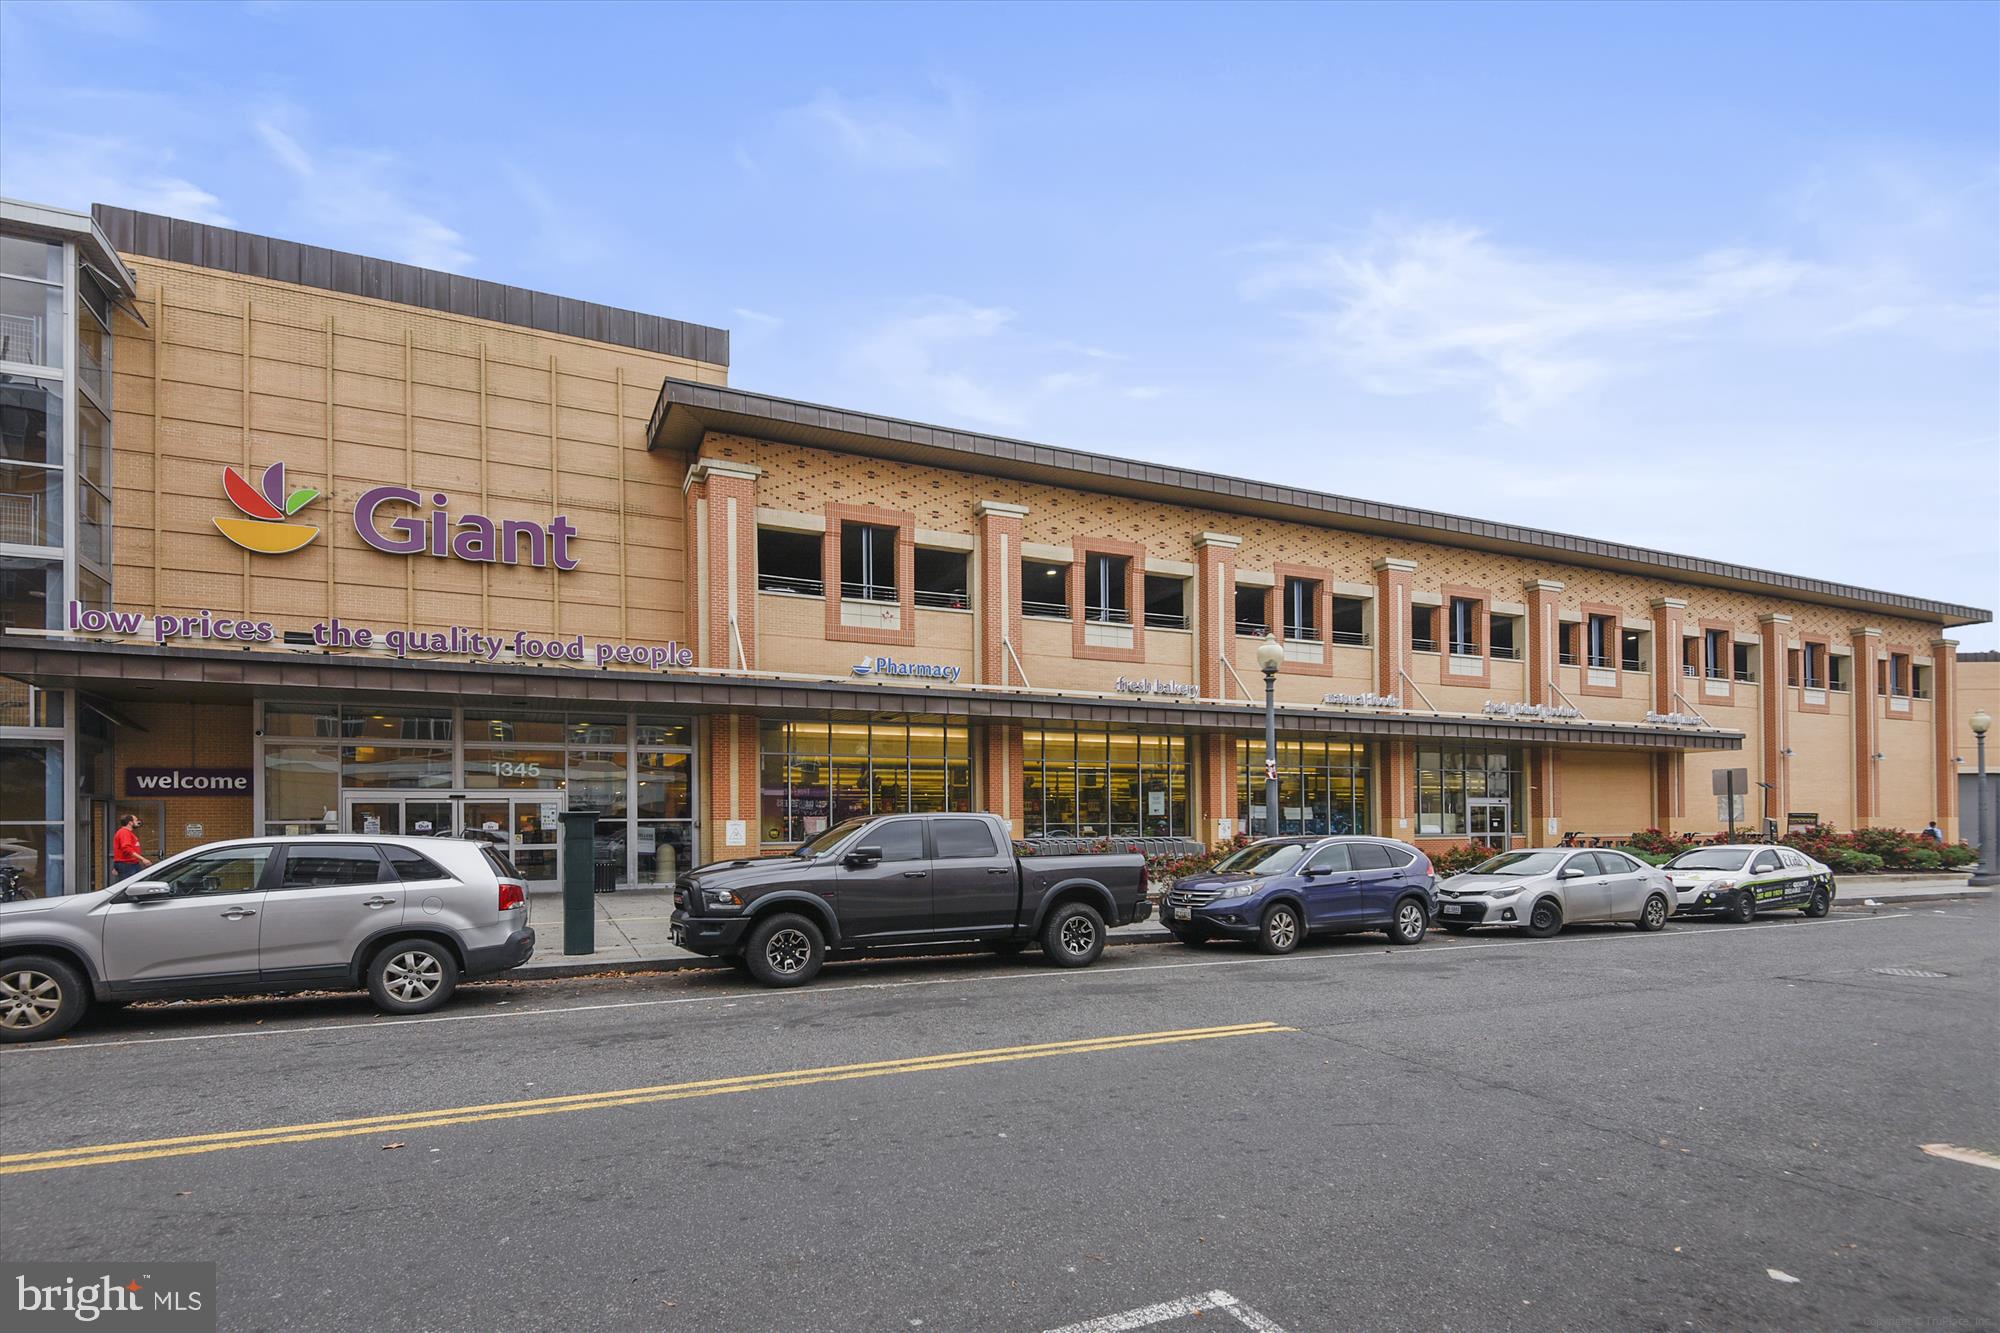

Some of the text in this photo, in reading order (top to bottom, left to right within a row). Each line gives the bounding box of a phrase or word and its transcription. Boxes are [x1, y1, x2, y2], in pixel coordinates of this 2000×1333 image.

[353, 486, 581, 570] Giant
[68, 600, 693, 669] low prices the quality food people
[876, 657, 961, 682] Pharmacy
[1115, 676, 1199, 698] fresh bakery
[136, 770, 247, 790] welcome
[492, 762, 540, 777] 1345
